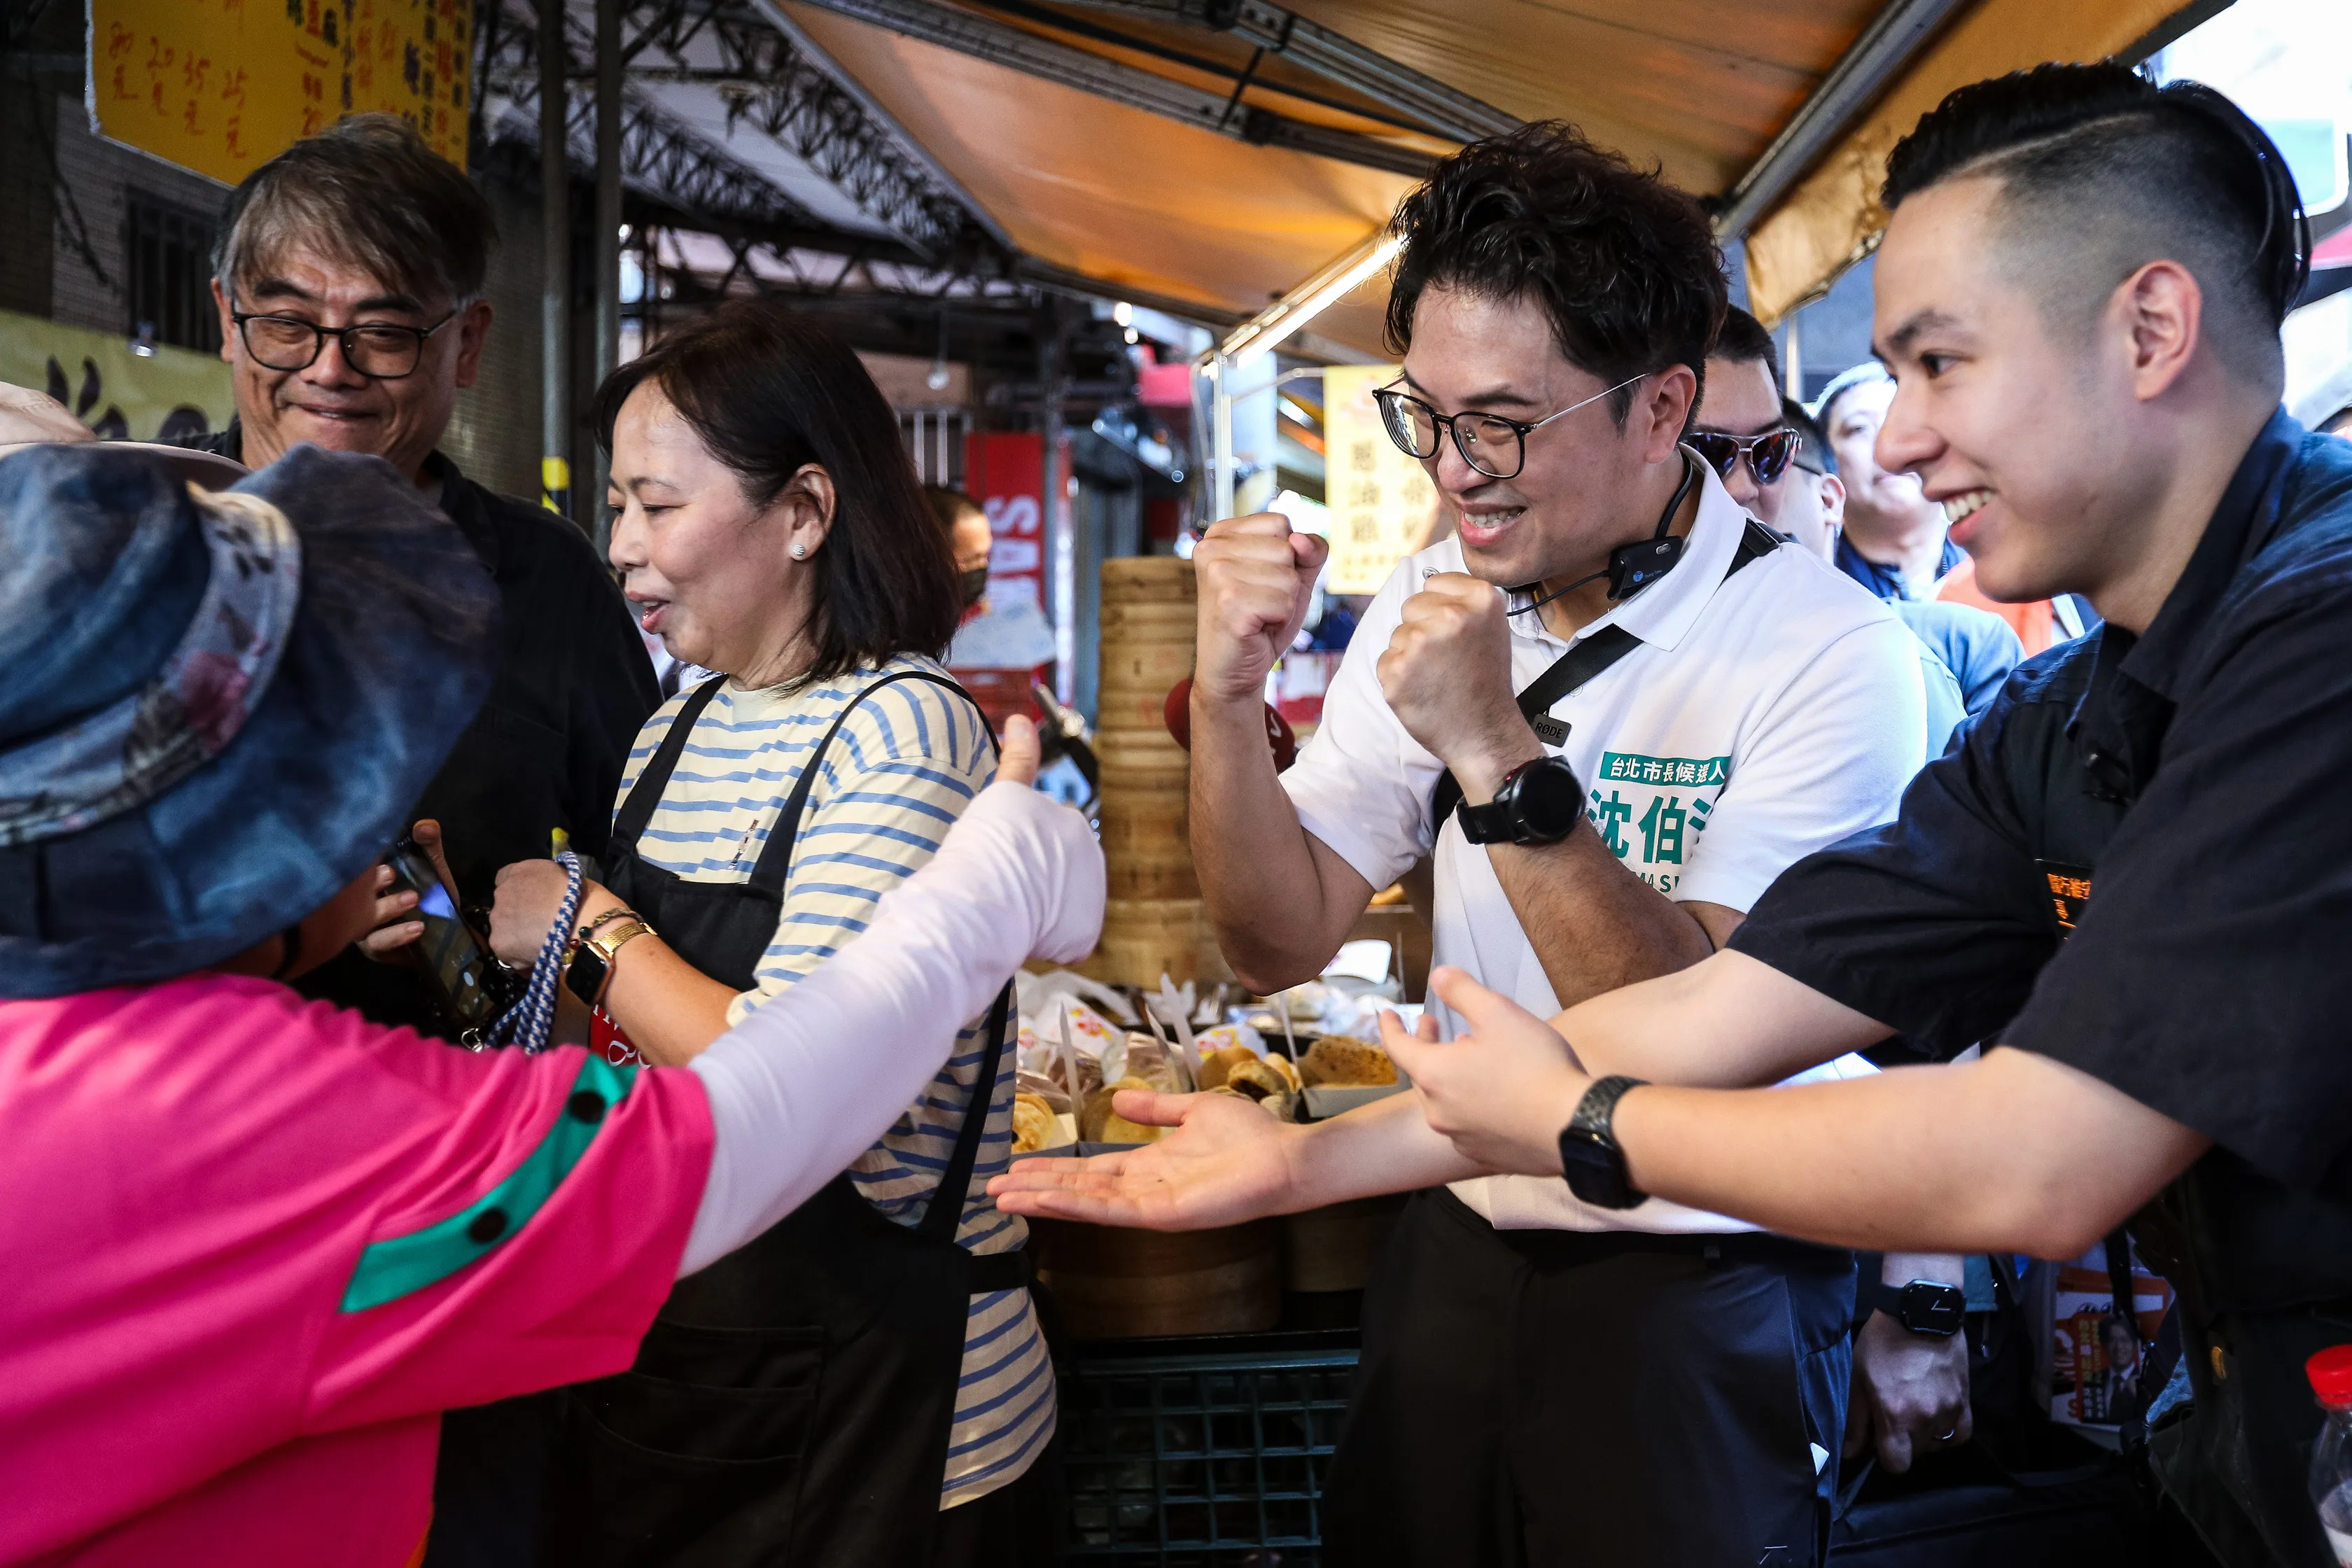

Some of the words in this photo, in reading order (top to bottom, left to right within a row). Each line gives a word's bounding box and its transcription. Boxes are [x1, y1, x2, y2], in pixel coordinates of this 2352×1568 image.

[1611, 757, 1726, 784] 台北市長候選人
[1586, 789, 1712, 864] 沈伯
